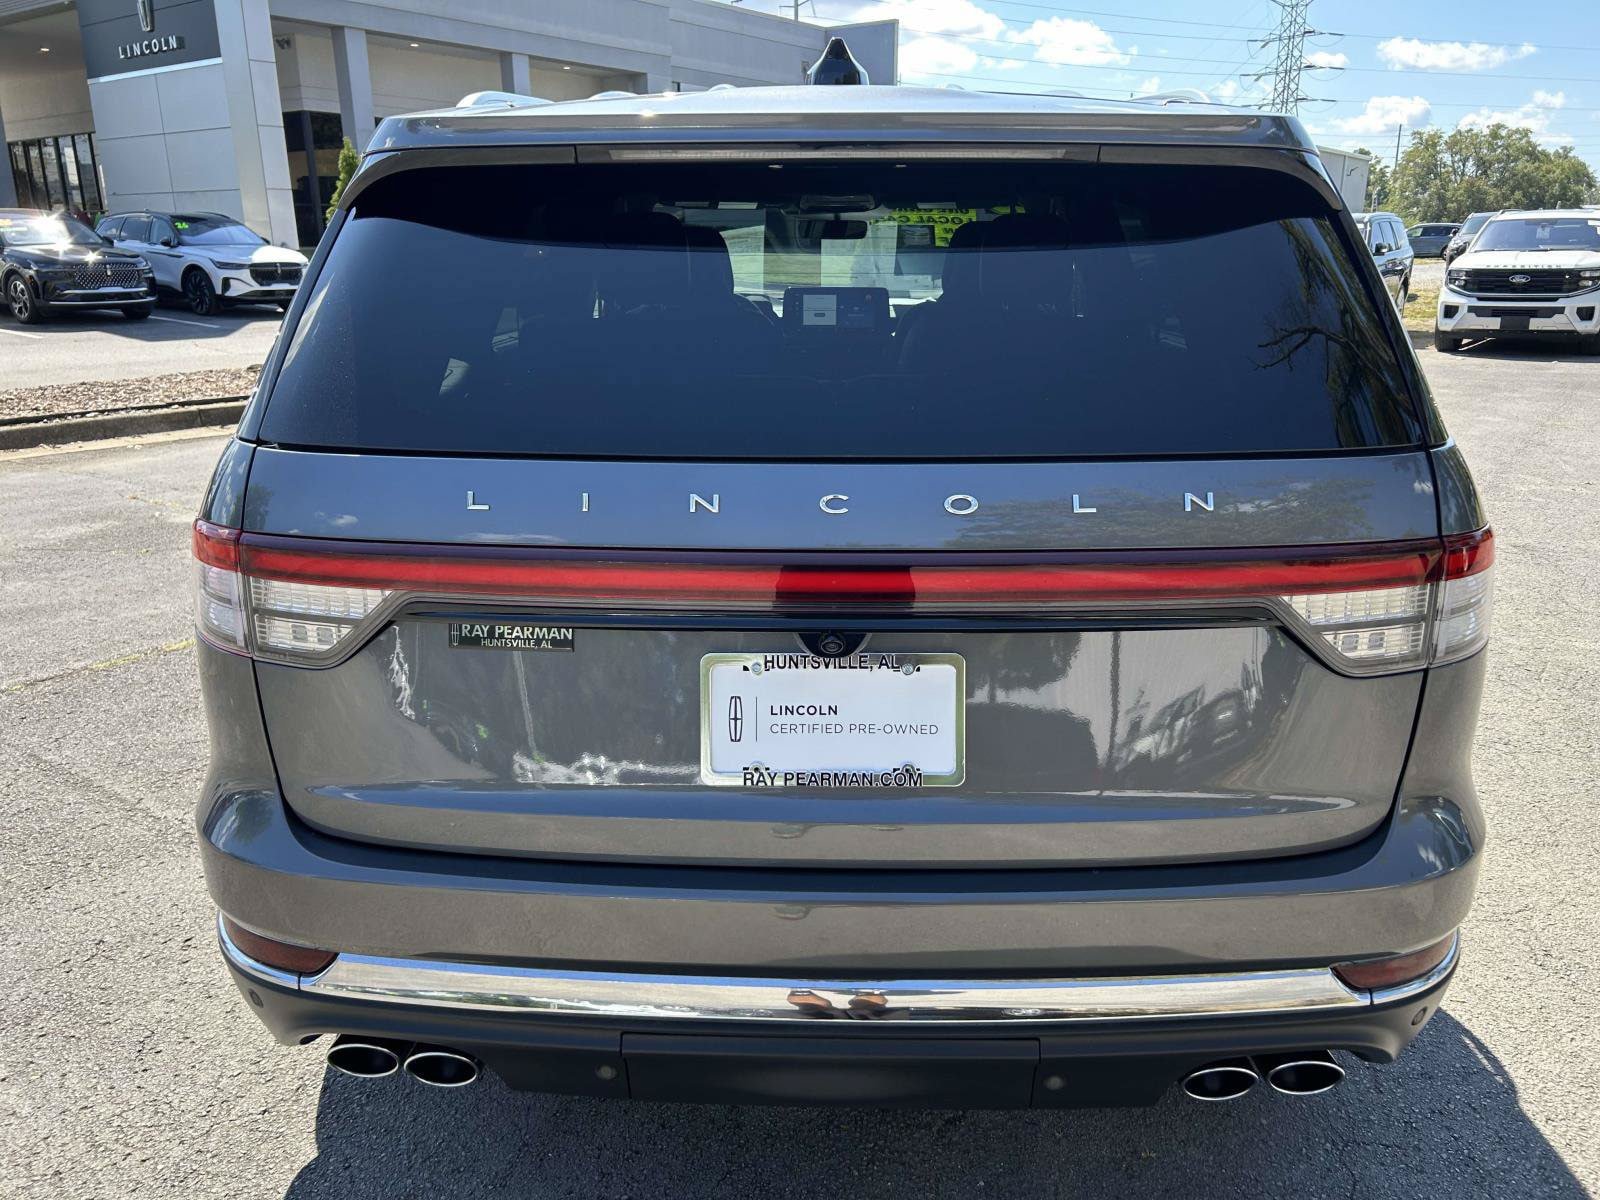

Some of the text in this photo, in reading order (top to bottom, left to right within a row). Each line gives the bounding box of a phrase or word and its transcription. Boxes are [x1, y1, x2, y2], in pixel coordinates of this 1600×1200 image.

[118, 35, 177, 59] LINCOLN
[466, 490, 1214, 515] LINCOLN
[461, 623, 573, 640] RAY PEARMAN
[481, 638, 553, 649] HUNTSVILLE, AL
[764, 654, 899, 671] HUNTSVILLE, AL
[770, 704, 838, 716] LINCOLN
[769, 723, 939, 735] CERTIFIED PRE-OWNED
[743, 772, 924, 787] RAY PEARMAN.COM
